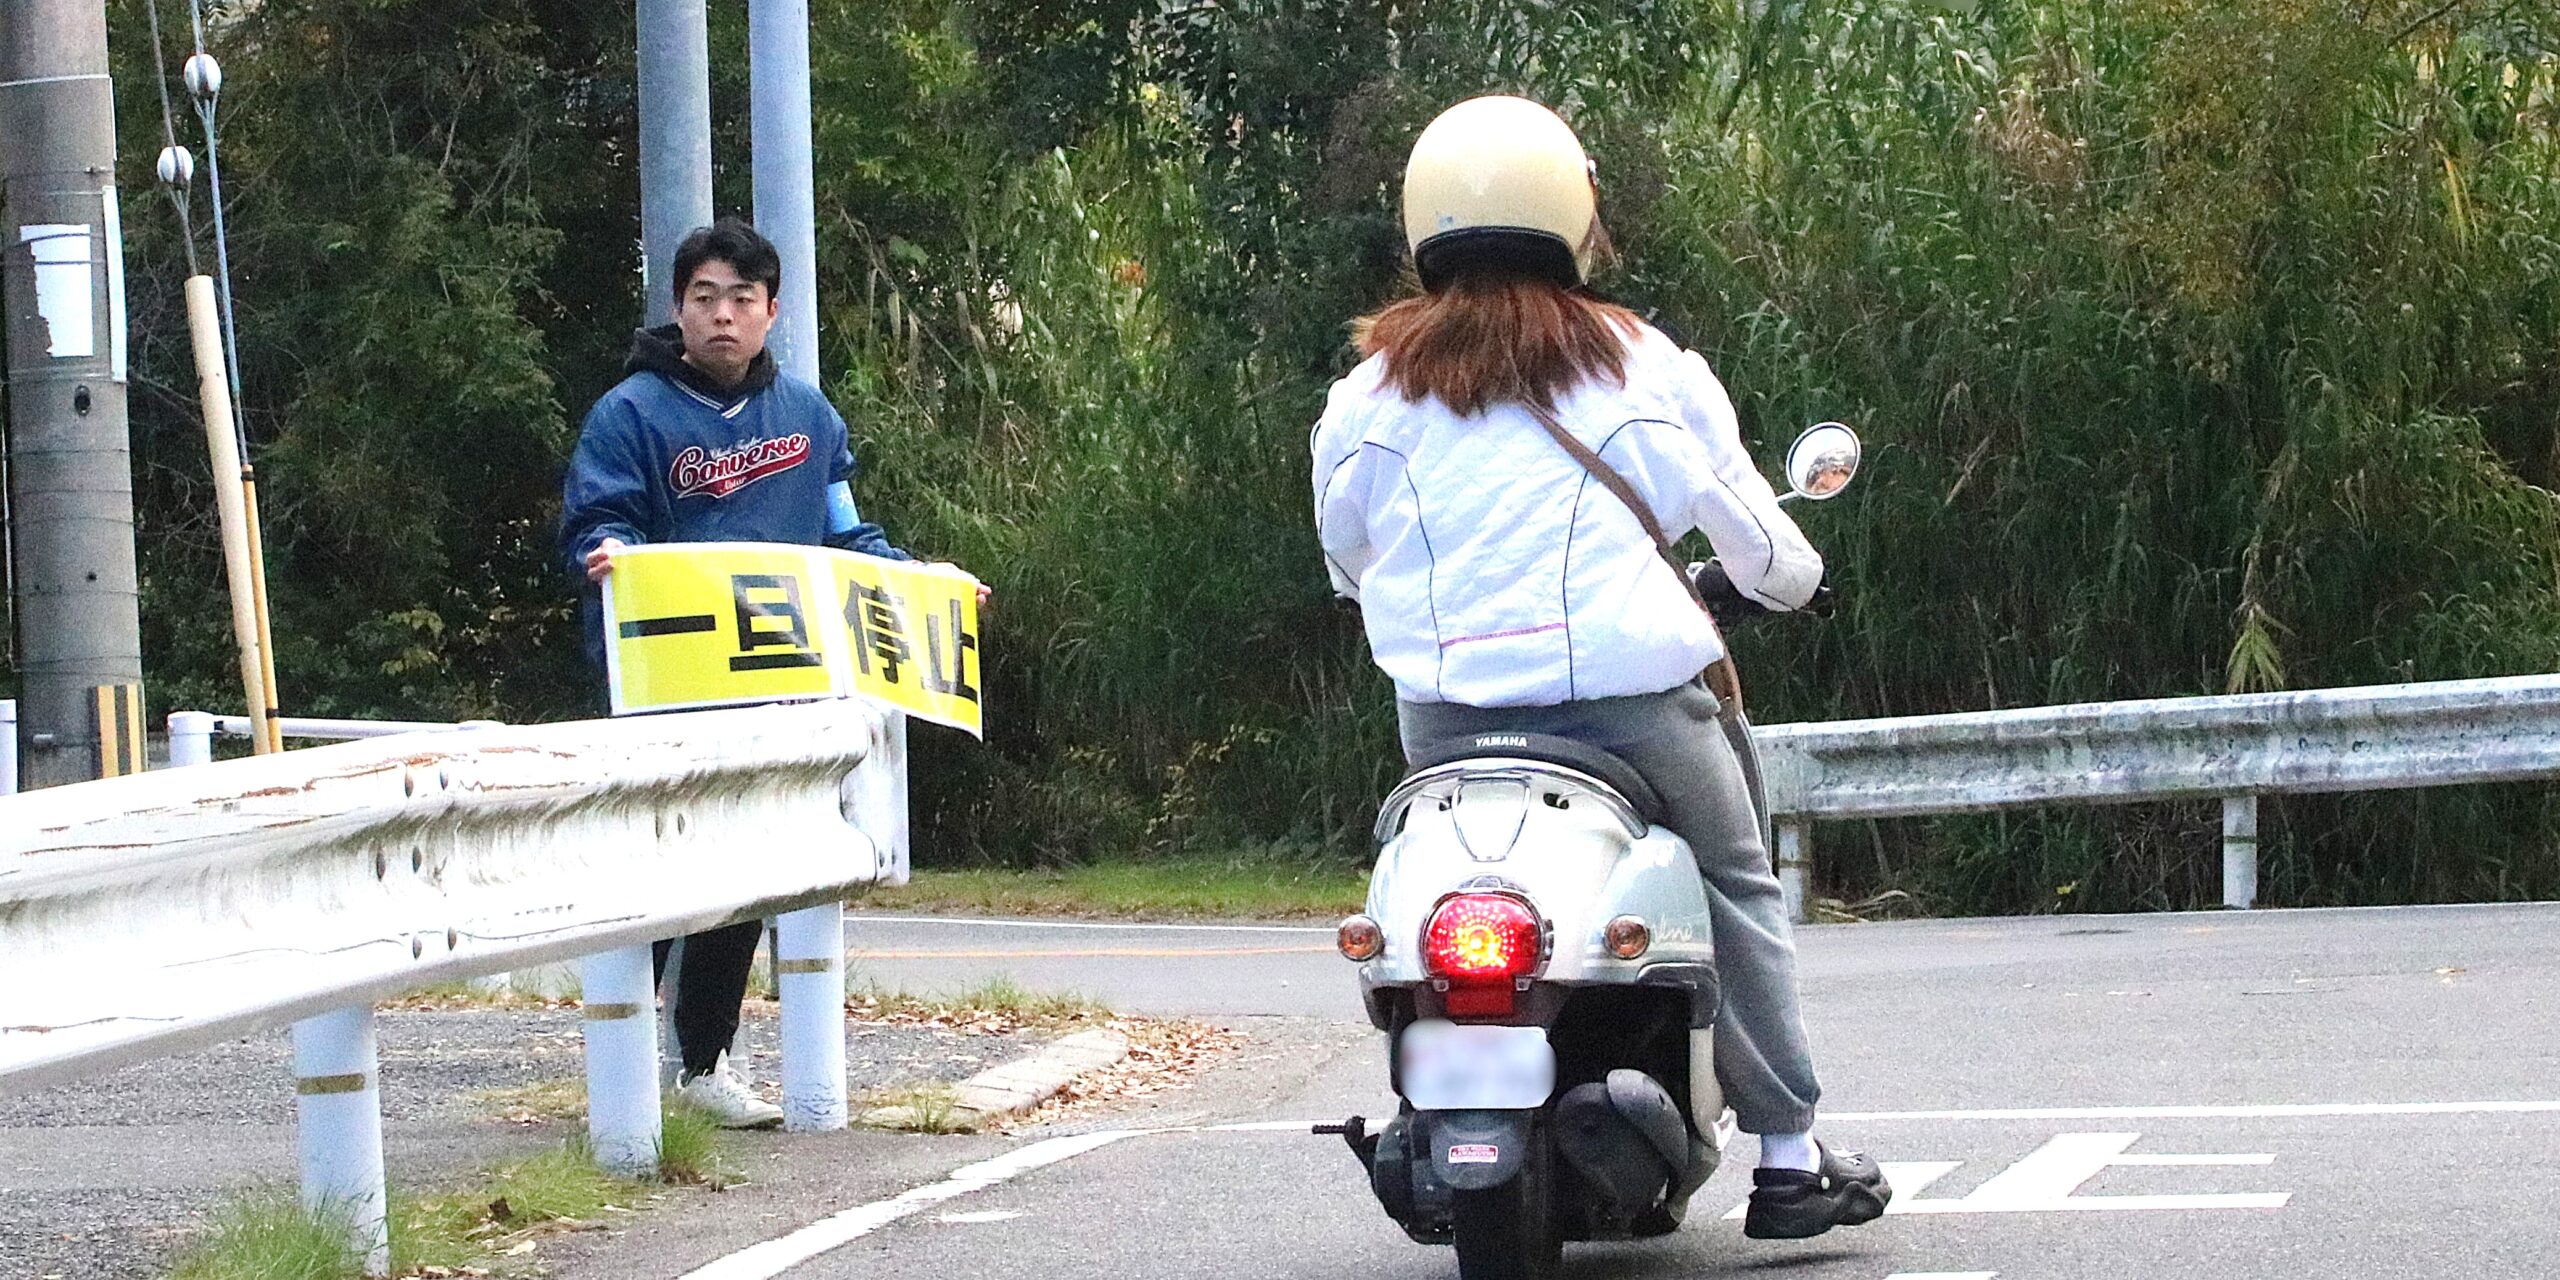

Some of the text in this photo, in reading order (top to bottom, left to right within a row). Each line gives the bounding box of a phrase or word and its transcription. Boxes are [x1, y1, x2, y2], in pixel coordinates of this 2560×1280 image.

[669, 433, 810, 494] Converse
[619, 573, 979, 706] 一旦停止
[1475, 735, 1528, 748] YAMAHA
